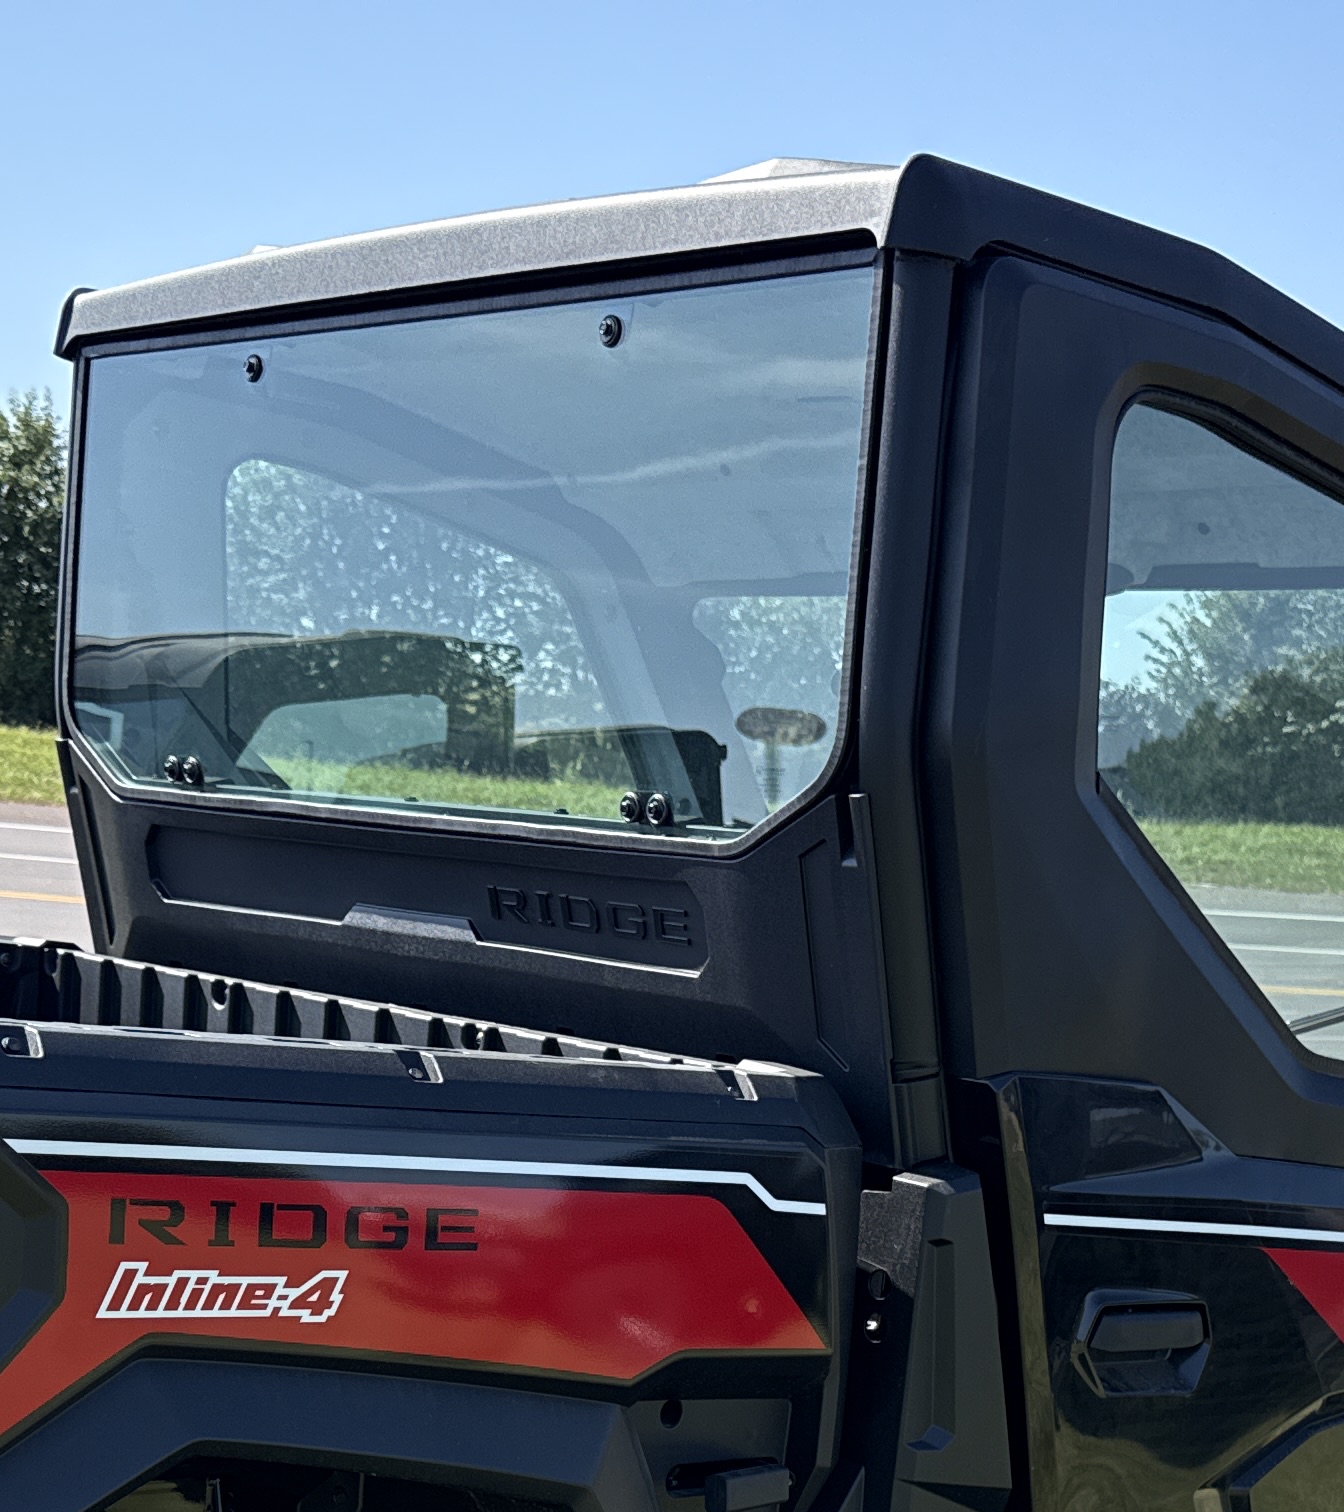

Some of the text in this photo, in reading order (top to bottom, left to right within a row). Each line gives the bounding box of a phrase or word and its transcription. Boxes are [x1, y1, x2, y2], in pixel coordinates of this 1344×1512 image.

[485, 884, 692, 946] RIDGE
[108, 1197, 479, 1252] RIDGE
[95, 1261, 349, 1323] Inline-4
